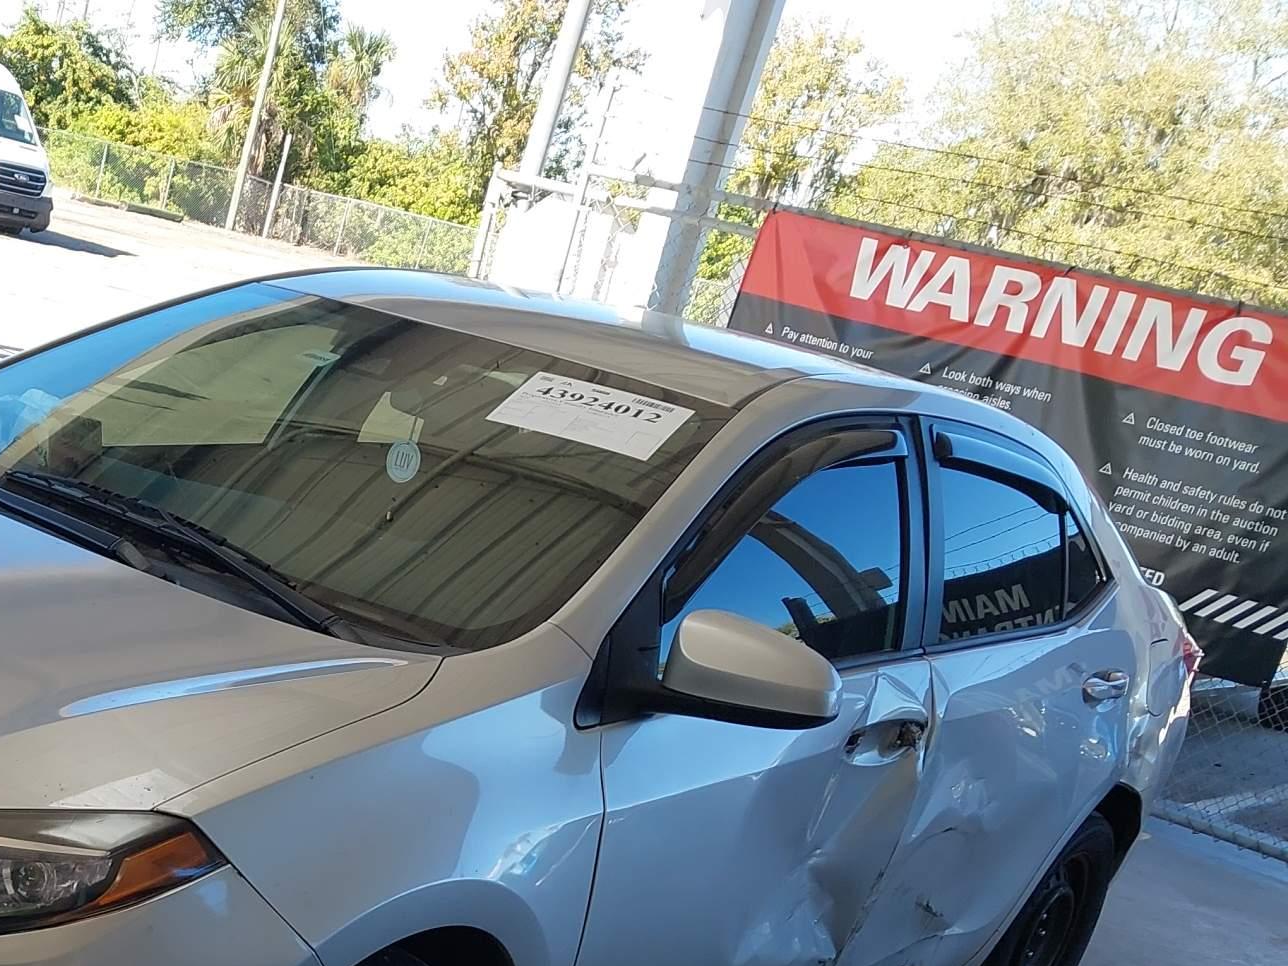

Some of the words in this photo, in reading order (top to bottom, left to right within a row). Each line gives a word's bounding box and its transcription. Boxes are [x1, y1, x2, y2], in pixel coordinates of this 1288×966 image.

[849, 237, 1273, 386] WARNING
[781, 327, 798, 343] Pay
[800, 333, 838, 352] attention
[839, 342, 850, 354] to
[850, 347, 874, 360] your
[941, 366, 968, 382] Look
[968, 372, 993, 388] both
[994, 381, 1021, 396] ways
[1022, 387, 1052, 402] when
[536, 387, 662, 423] 43924012
[1146, 416, 1186, 436] Closed
[1185, 428, 1204, 440] toe
[1205, 431, 1260, 453] footwear
[1138, 435, 1169, 451] must
[1168, 440, 1183, 454] be
[1184, 447, 1214, 462] worn
[1215, 455, 1231, 466] on
[1231, 459, 1261, 474] yard.
[1114, 485, 1152, 503] permit
[1152, 494, 1195, 515] children
[1196, 504, 1208, 517] in
[1210, 510, 1231, 523] the
[1232, 517, 1279, 536] auction
[1122, 467, 1159, 487] Health
[1159, 479, 1183, 492] and
[1182, 485, 1218, 503] safety
[1218, 495, 1248, 510] rules
[1248, 501, 1264, 514] do
[1265, 507, 1288, 520] not
[1108, 502, 1136, 516] yard
[1135, 509, 1150, 520] or
[1150, 511, 1193, 534] bidding
[1194, 525, 1224, 542] area,
[1227, 534, 1257, 550] even
[1258, 540, 1272, 552] if
[1175, 535, 1192, 552] by
[1192, 543, 1207, 555] an
[1208, 547, 1241, 563] adult.
